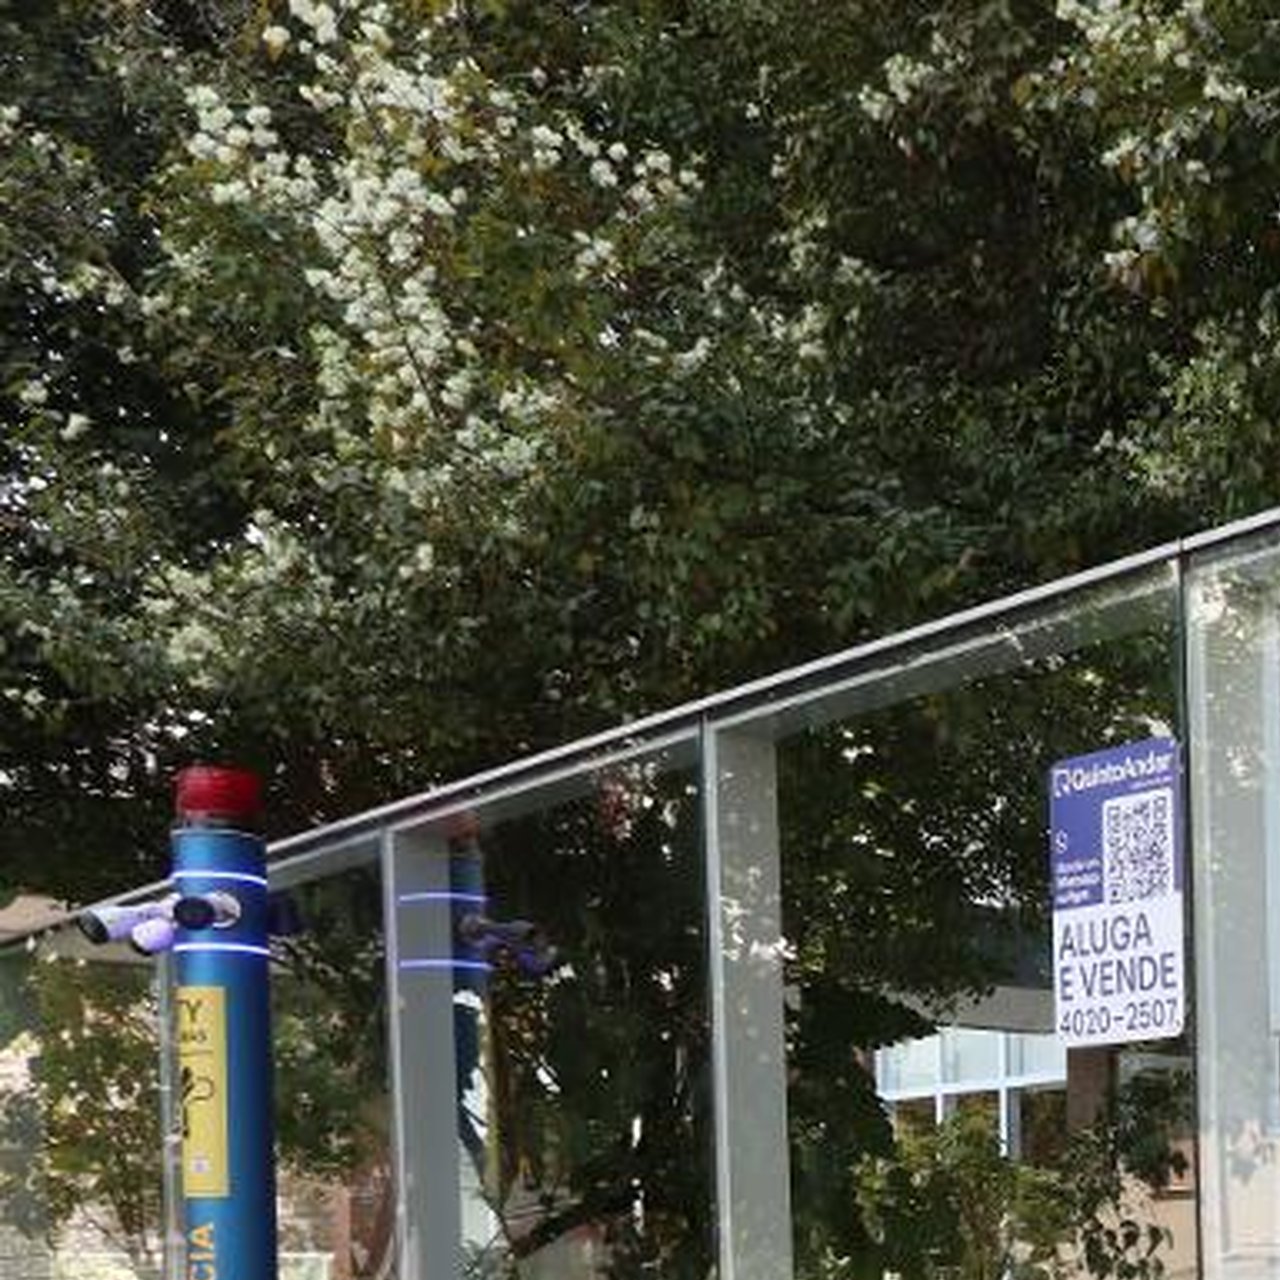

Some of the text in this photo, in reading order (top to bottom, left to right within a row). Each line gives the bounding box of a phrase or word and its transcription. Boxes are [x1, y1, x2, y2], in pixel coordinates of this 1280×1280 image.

[1060, 912, 1154, 960] ALUGA
[1060, 952, 1177, 1001] E VENDE
[1060, 999, 1177, 1036] 4020-2507
